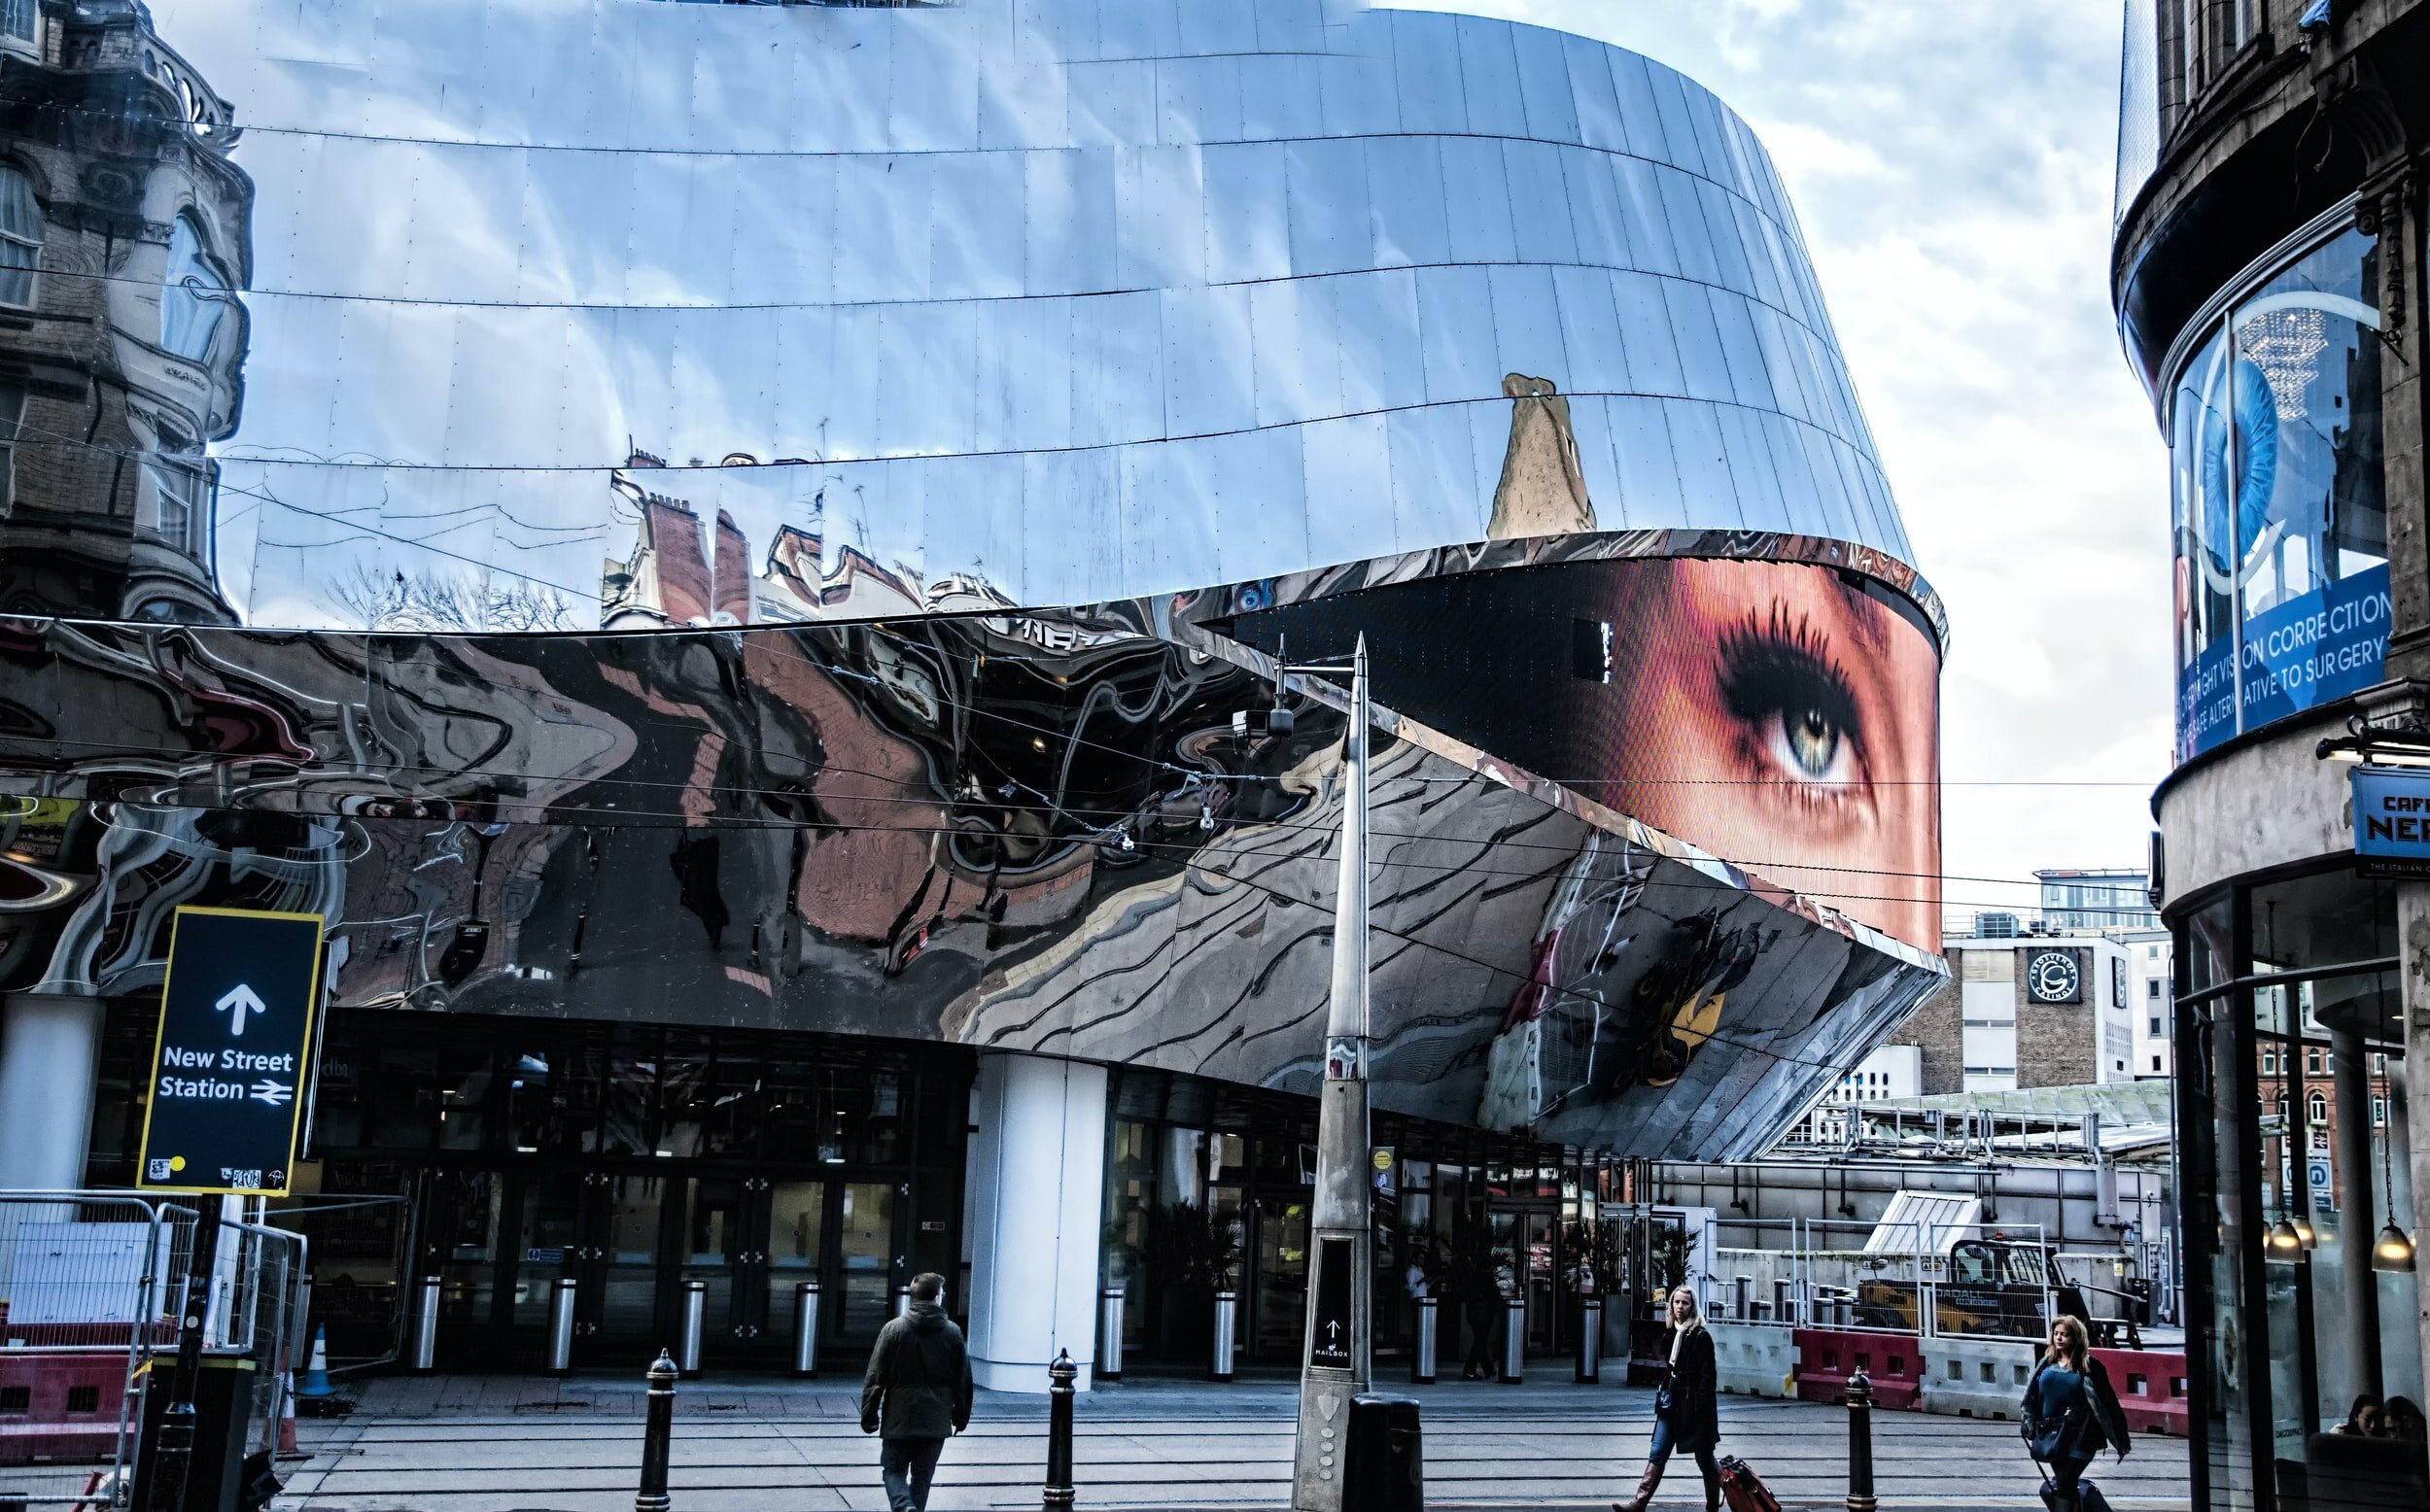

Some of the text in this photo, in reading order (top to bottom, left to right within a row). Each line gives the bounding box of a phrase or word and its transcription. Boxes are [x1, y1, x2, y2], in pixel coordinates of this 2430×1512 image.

[2181, 591, 2392, 717] OVERNIGHT VISON CORRECTION
[2281, 665, 2302, 691] TO
[2306, 636, 2384, 682] SURGERY
[2031, 954, 2074, 974] GROSVENOR
[2034, 986, 2072, 1000] CASINOS
[164, 1047, 294, 1072] New Street
[159, 1077, 244, 1100] Station
[1315, 1349, 1348, 1357] MAILBOX
